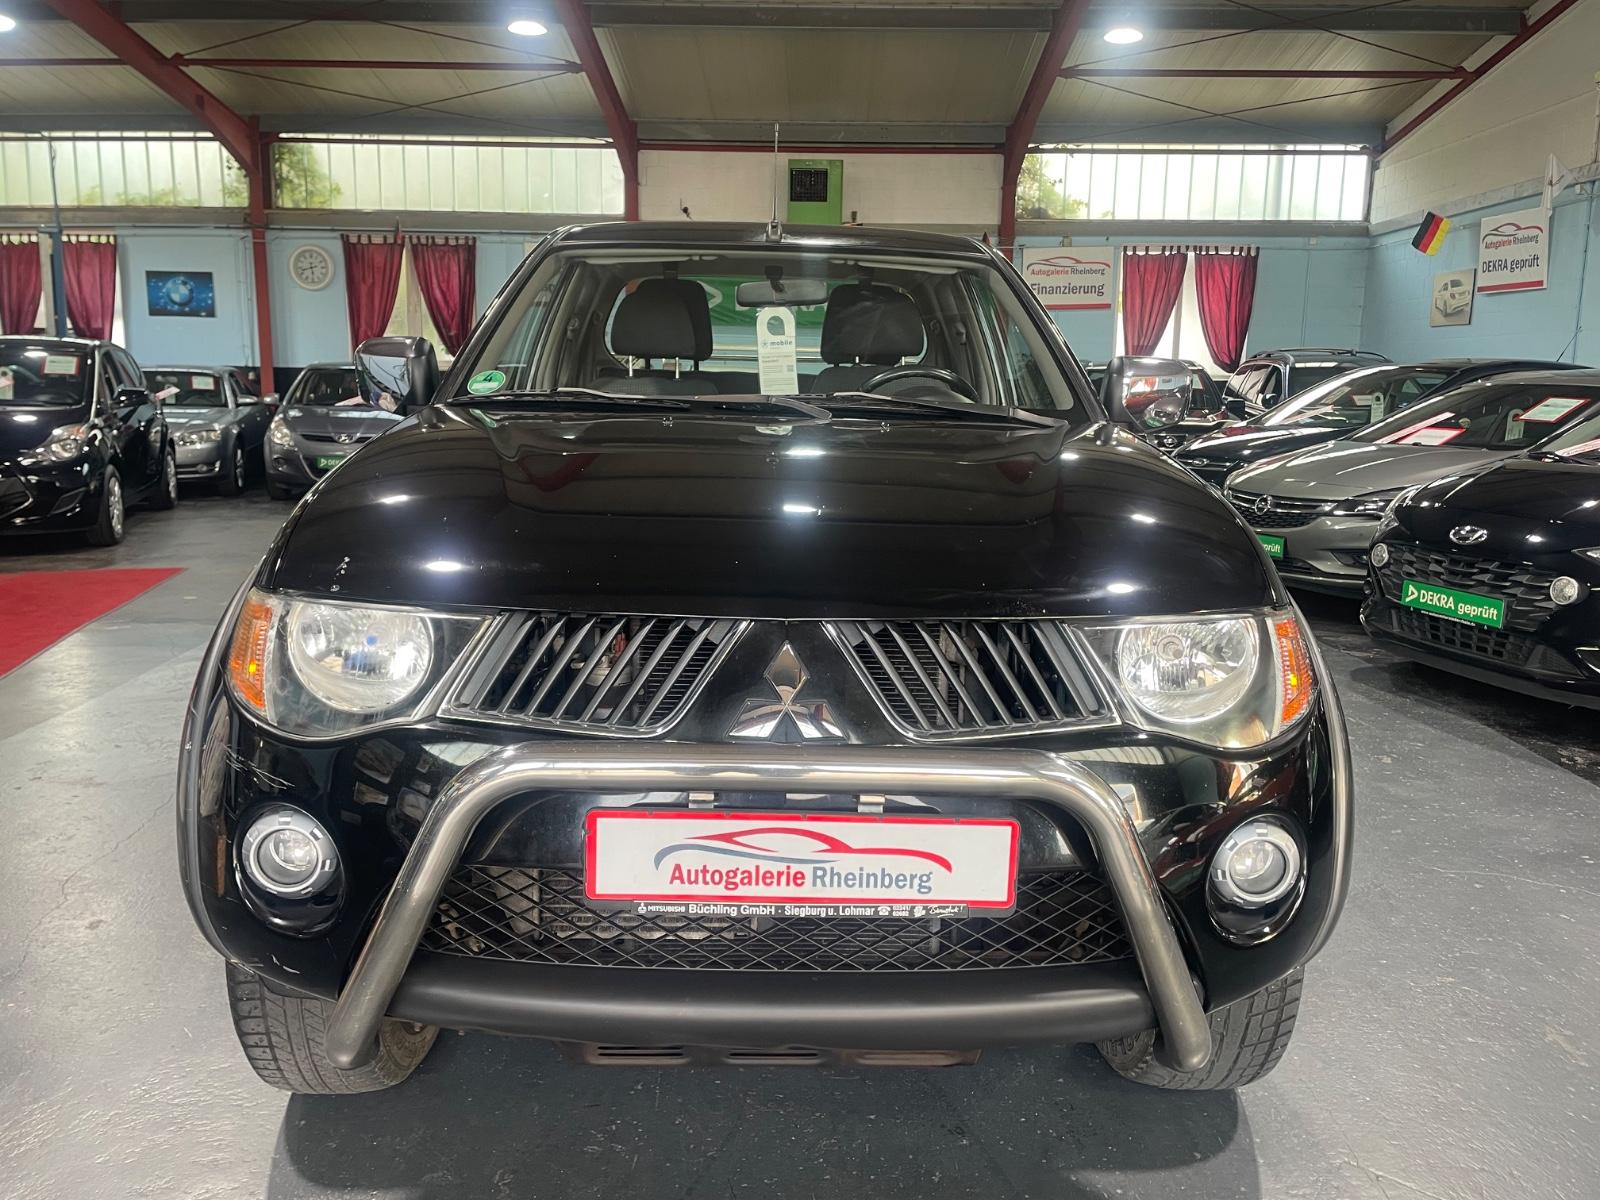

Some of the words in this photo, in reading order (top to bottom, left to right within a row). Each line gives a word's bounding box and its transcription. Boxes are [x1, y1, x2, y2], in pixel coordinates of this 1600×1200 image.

[1485, 238, 1512, 249] Autogalerie
[1513, 234, 1538, 245] Rheinberg
[1482, 259, 1508, 273] DEKRA
[1510, 254, 1540, 272] geprüft
[1031, 268, 1068, 276] Autogalerie
[1070, 267, 1105, 275] Rheinberg
[1030, 283, 1104, 297] Finanzierung
[482, 372, 493, 382] 4
[1420, 589, 1455, 610] DEKRA
[1458, 602, 1498, 620] geprüft
[669, 863, 806, 891] Autogalerie
[812, 866, 933, 895] Rheinberg
[647, 905, 686, 913] MITSUBISHI
[688, 903, 738, 917] Büchling
[740, 904, 775, 915] GmbH
[784, 905, 827, 917] Siegburg
[828, 906, 837, 916] u.
[839, 905, 875, 916] Lohmar
